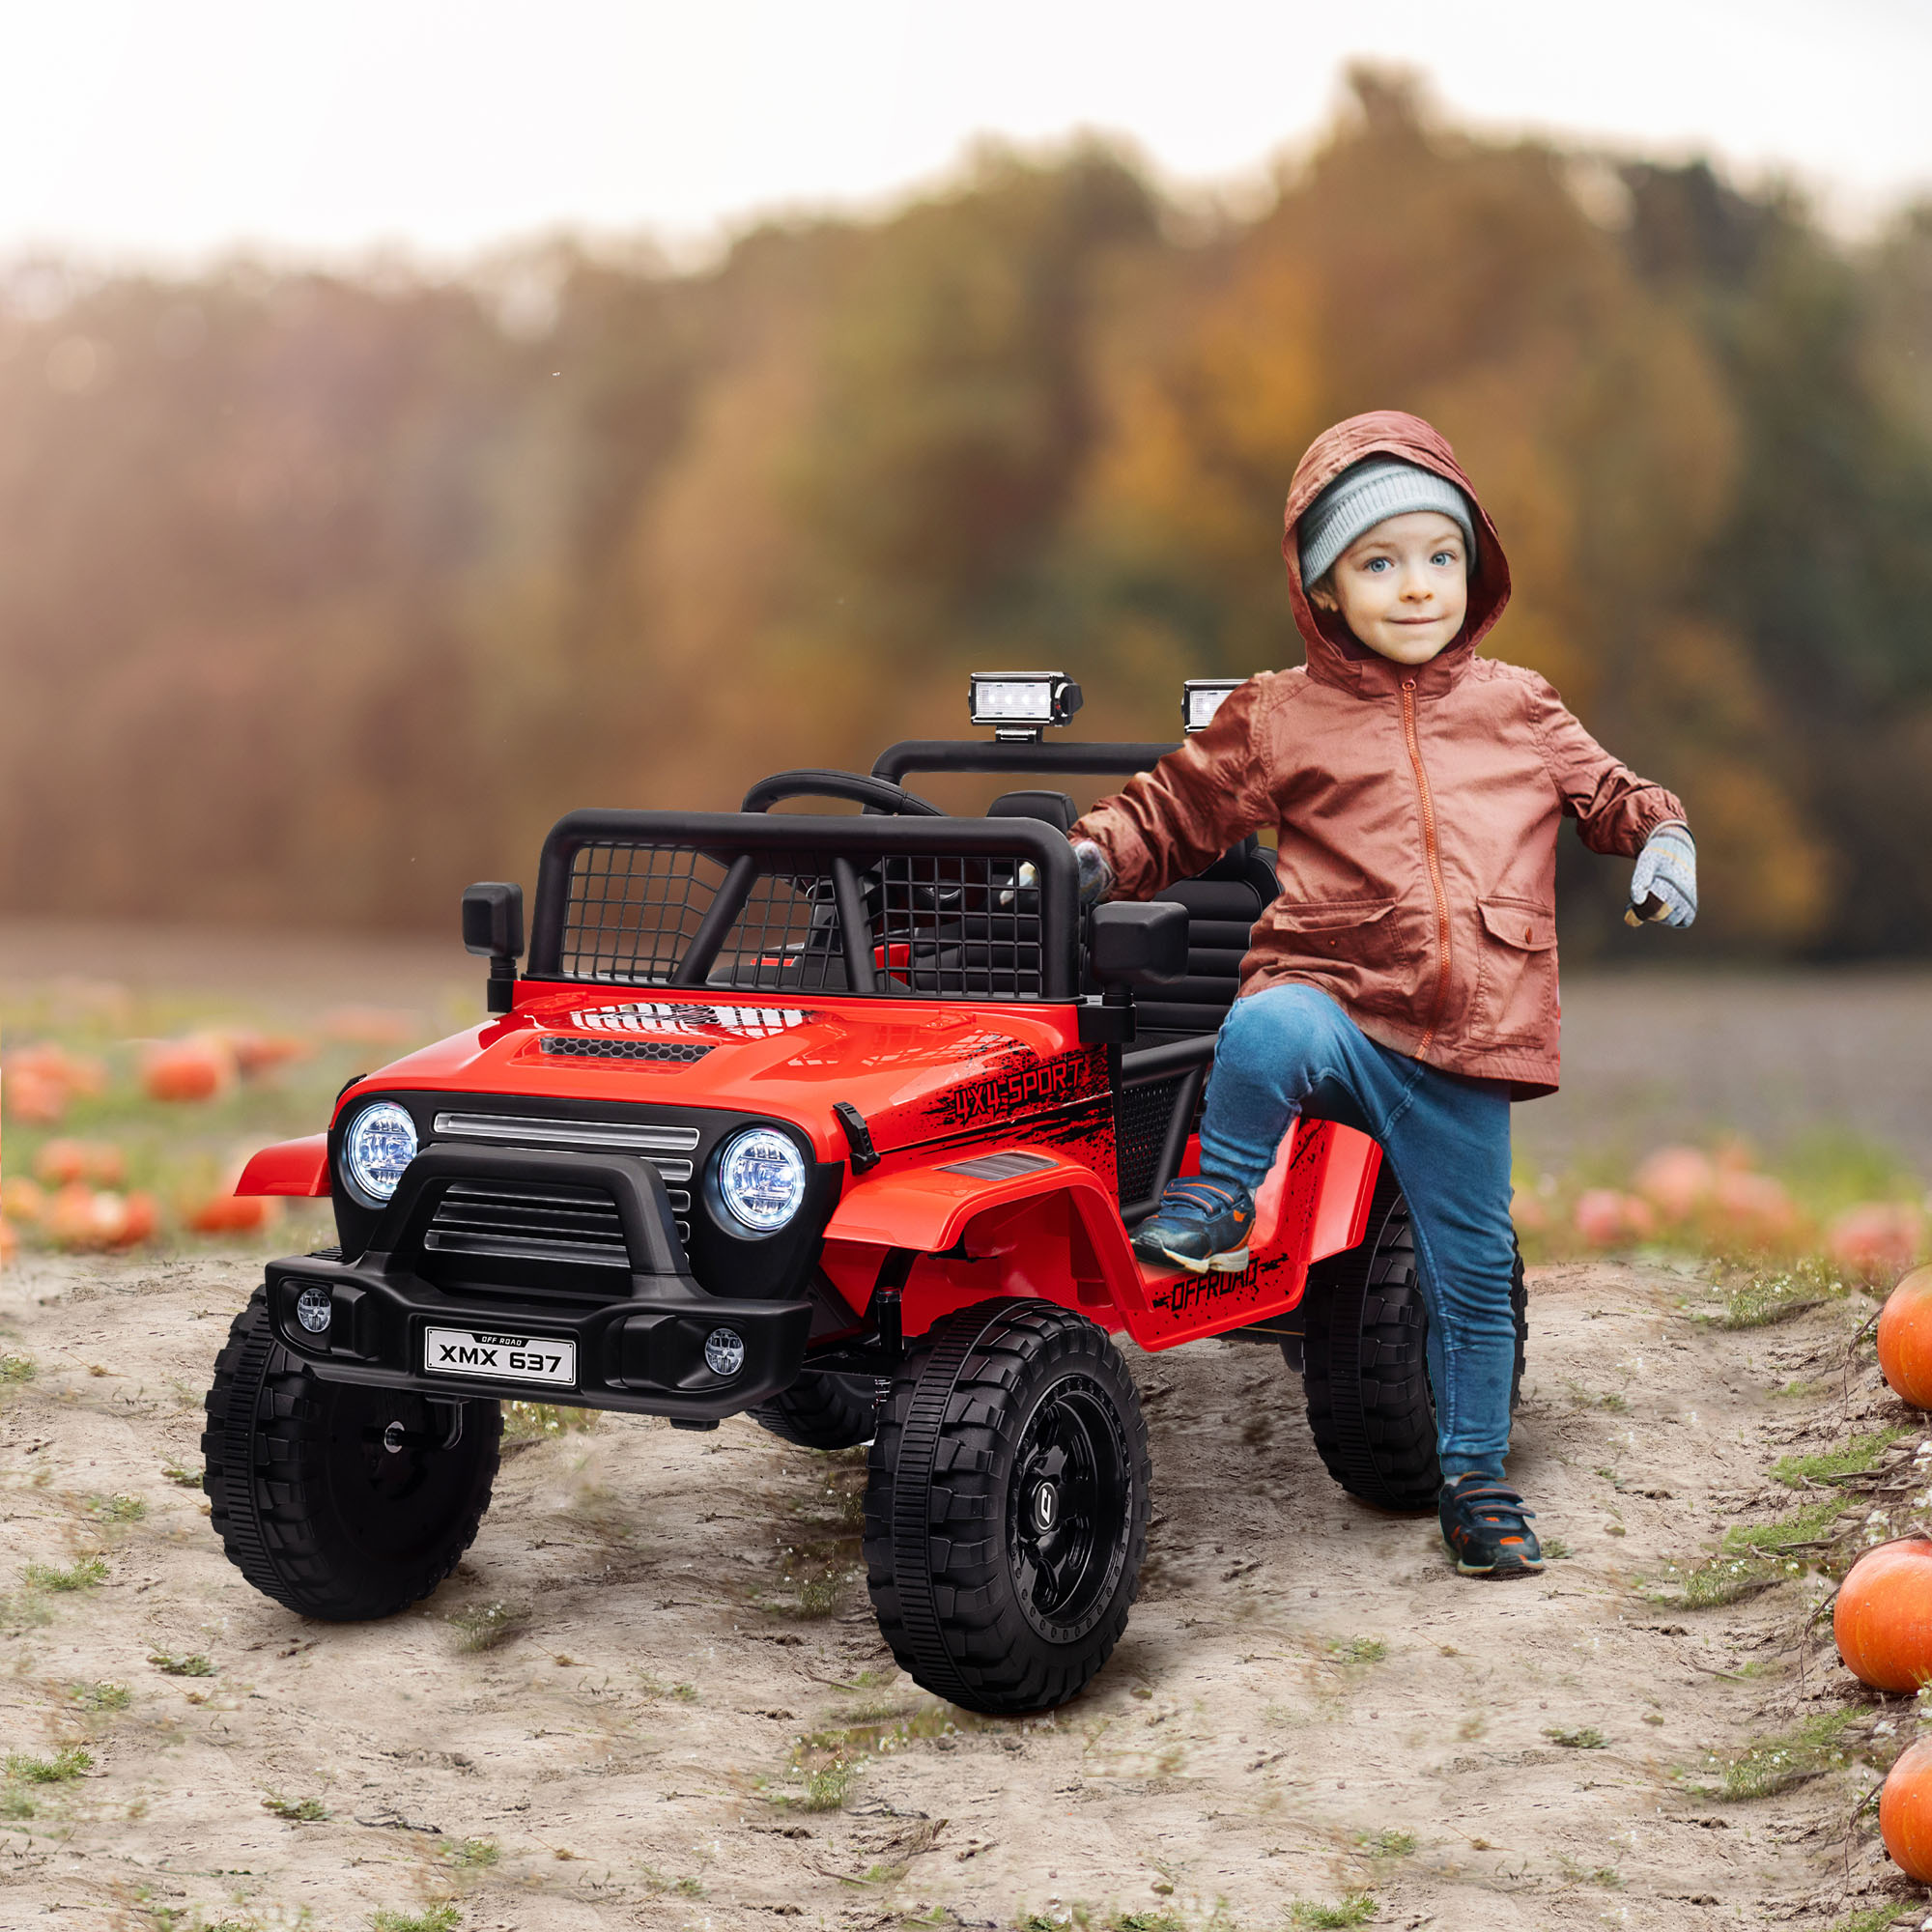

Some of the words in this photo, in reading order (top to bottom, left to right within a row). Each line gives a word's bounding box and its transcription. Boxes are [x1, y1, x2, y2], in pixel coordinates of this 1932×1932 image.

[1008, 1058, 1085, 1104] SPORT
[1171, 1257, 1261, 1312] OFFROAD
[439, 1344, 498, 1367] XMX
[509, 1351, 562, 1373] 637
[499, 1338, 523, 1347] ROAD
